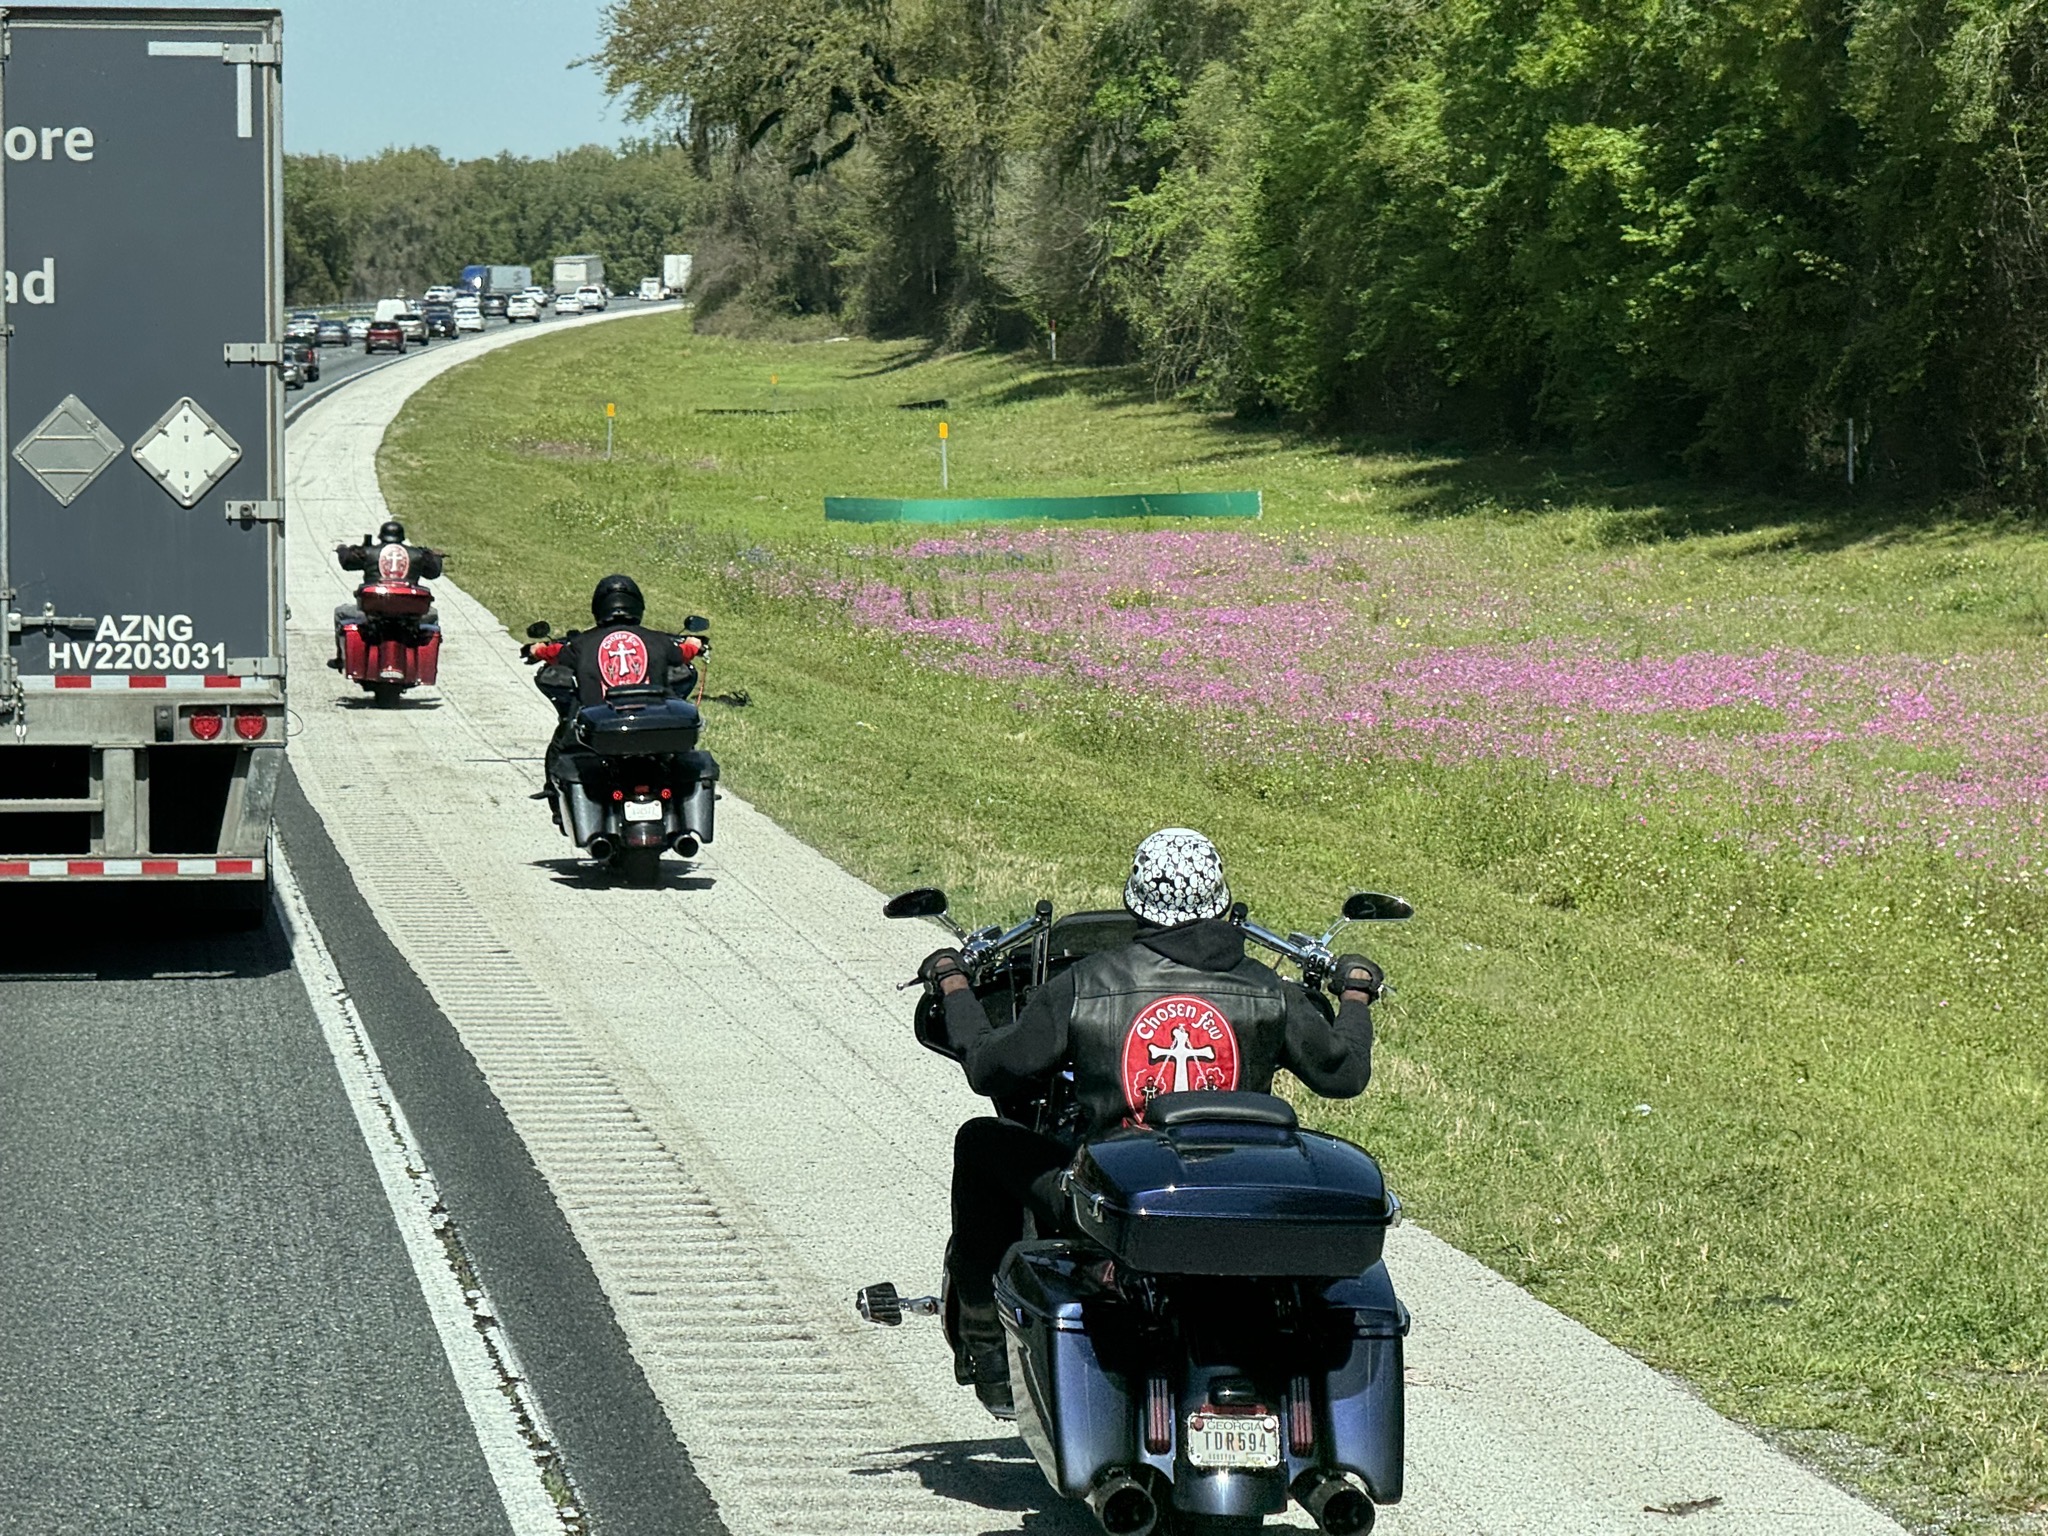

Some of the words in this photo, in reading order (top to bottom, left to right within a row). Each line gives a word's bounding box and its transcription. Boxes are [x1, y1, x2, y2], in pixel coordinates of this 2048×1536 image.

[95, 614, 194, 642] AZNG
[49, 642, 226, 669] HV2203031
[1136, 1003, 1197, 1040] Chosen
[1206, 1421, 1262, 1431] GEORGIA
[1203, 1431, 1267, 1453] TDR594
